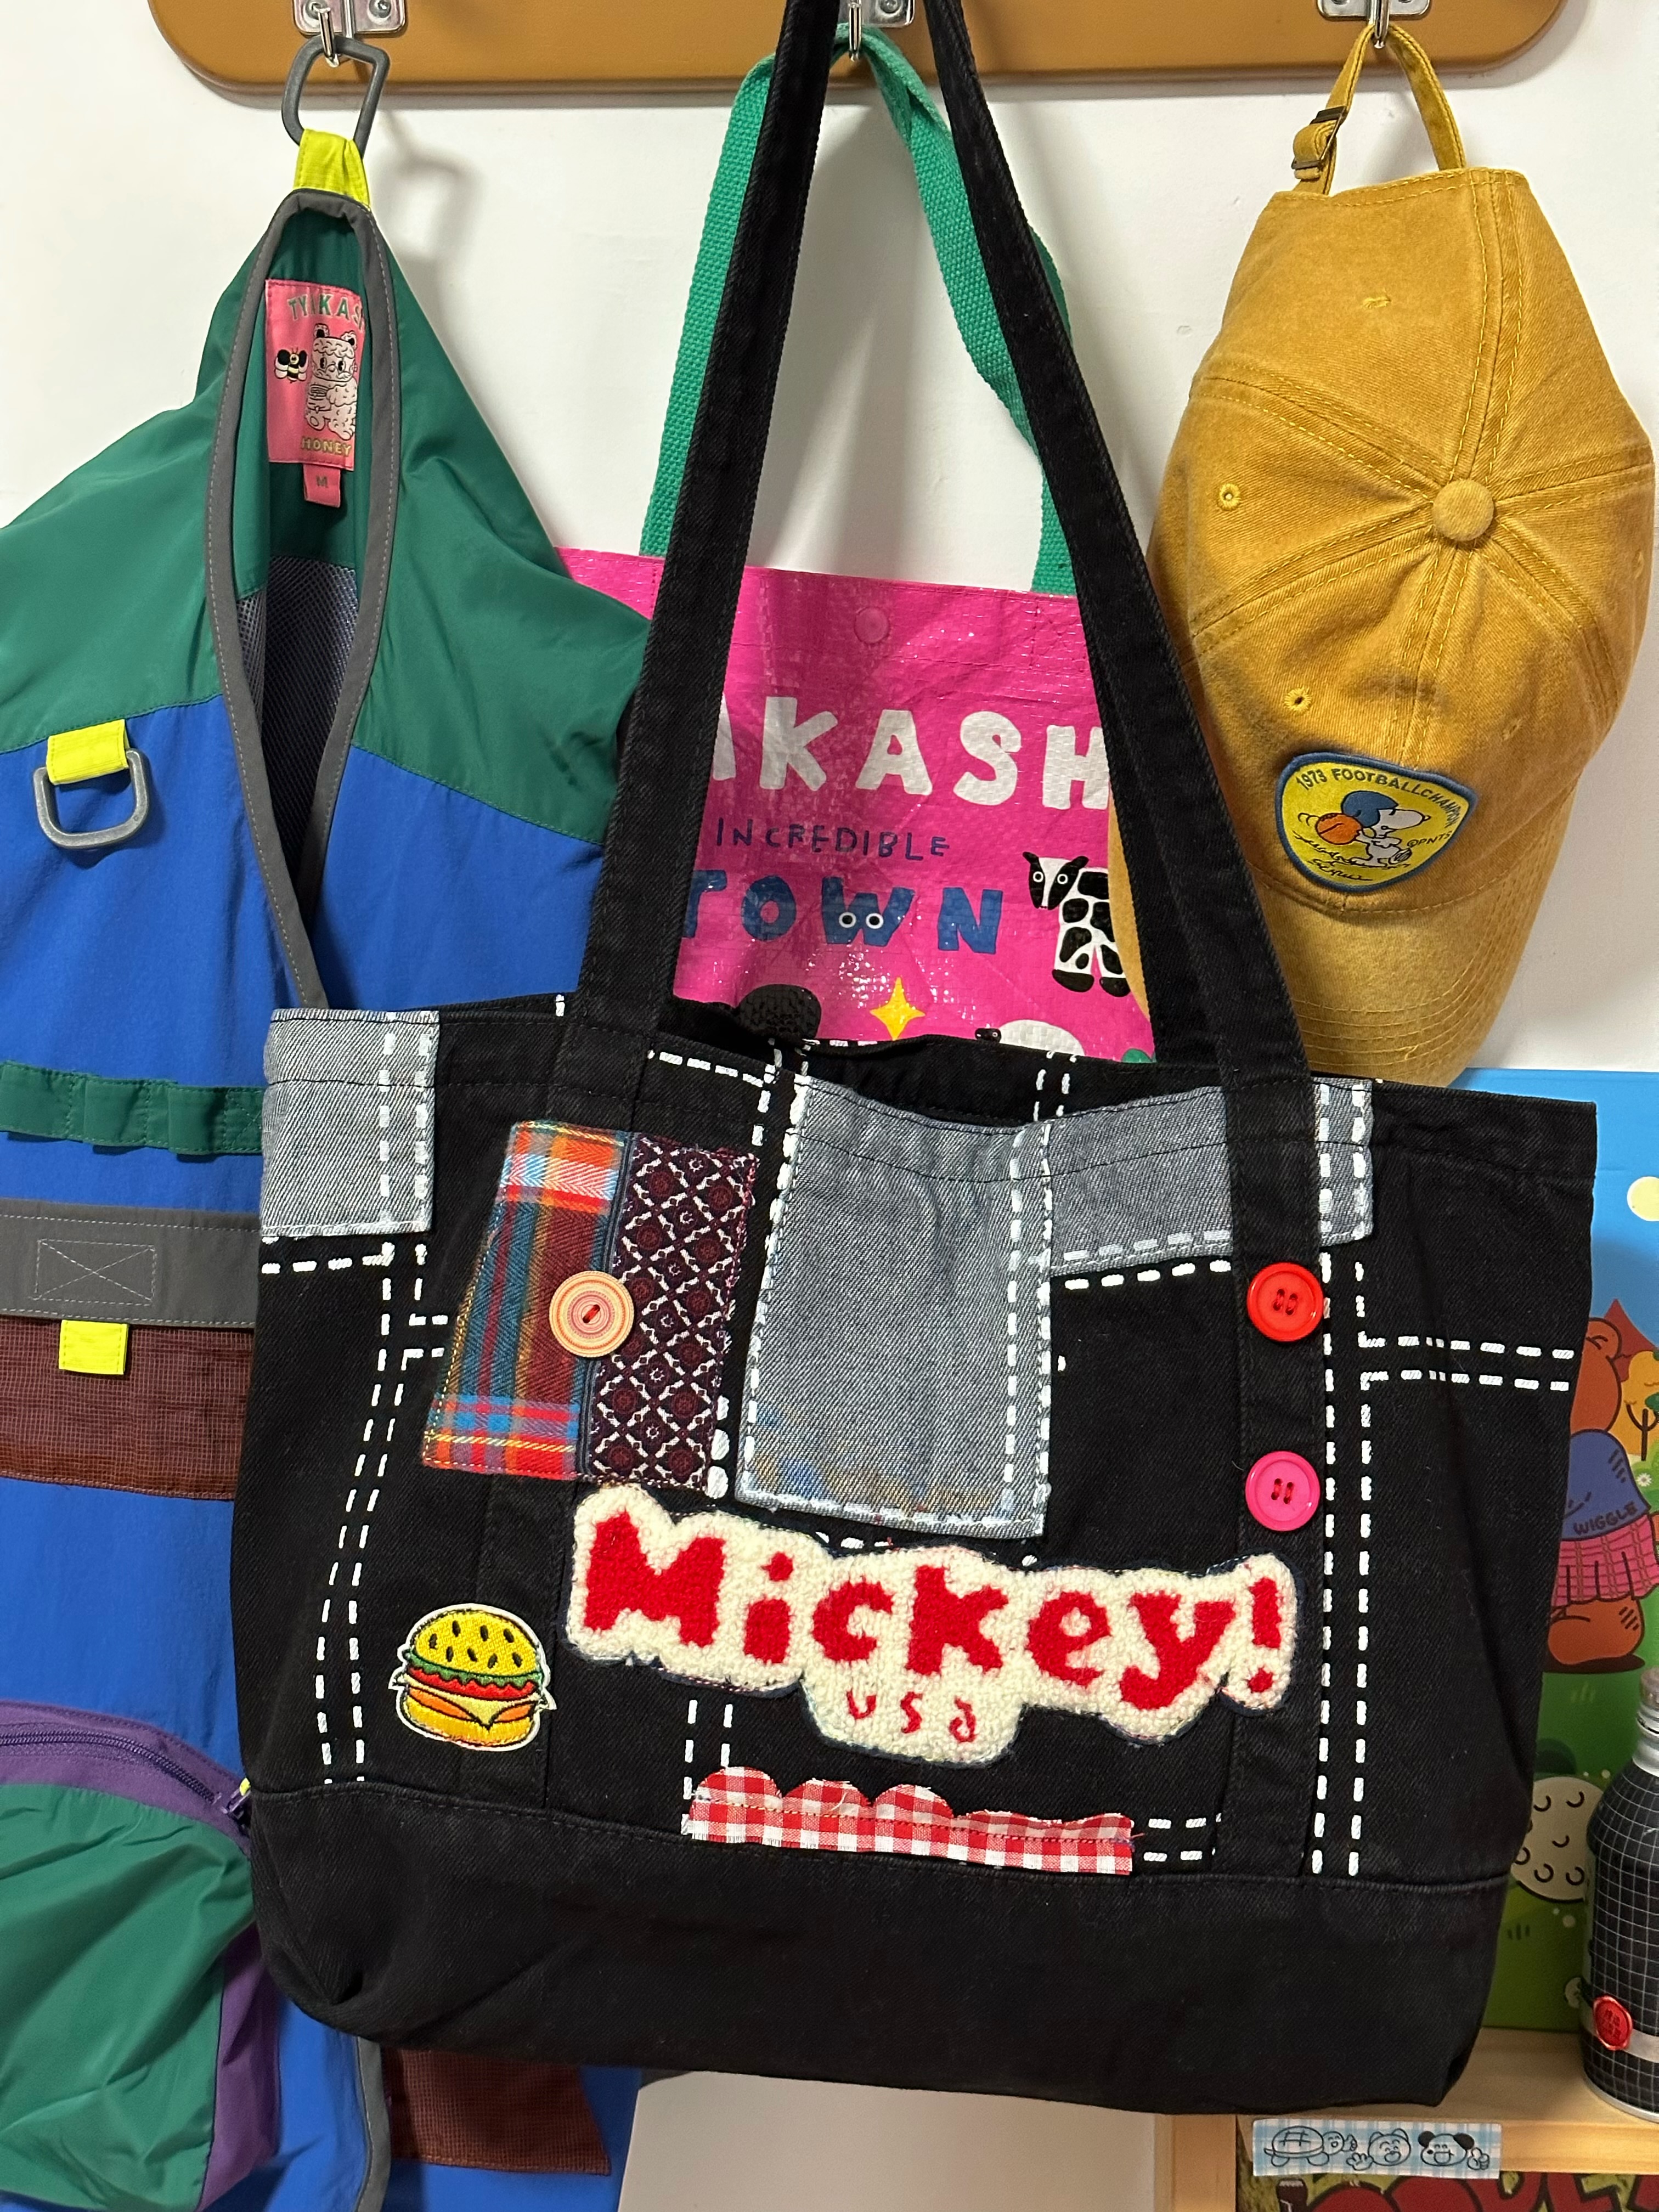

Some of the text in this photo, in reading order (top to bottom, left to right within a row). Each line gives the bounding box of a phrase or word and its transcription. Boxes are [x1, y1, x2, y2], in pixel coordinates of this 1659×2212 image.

[301, 437, 352, 456] HONEY
[1296, 769, 1327, 790] 1973
[716, 817, 950, 860] INCREDIBLE
[682, 870, 1003, 955] TOWN
[1573, 1501, 1637, 1536] WIGGLE
[583, 1509, 1282, 1711] Mickey!
